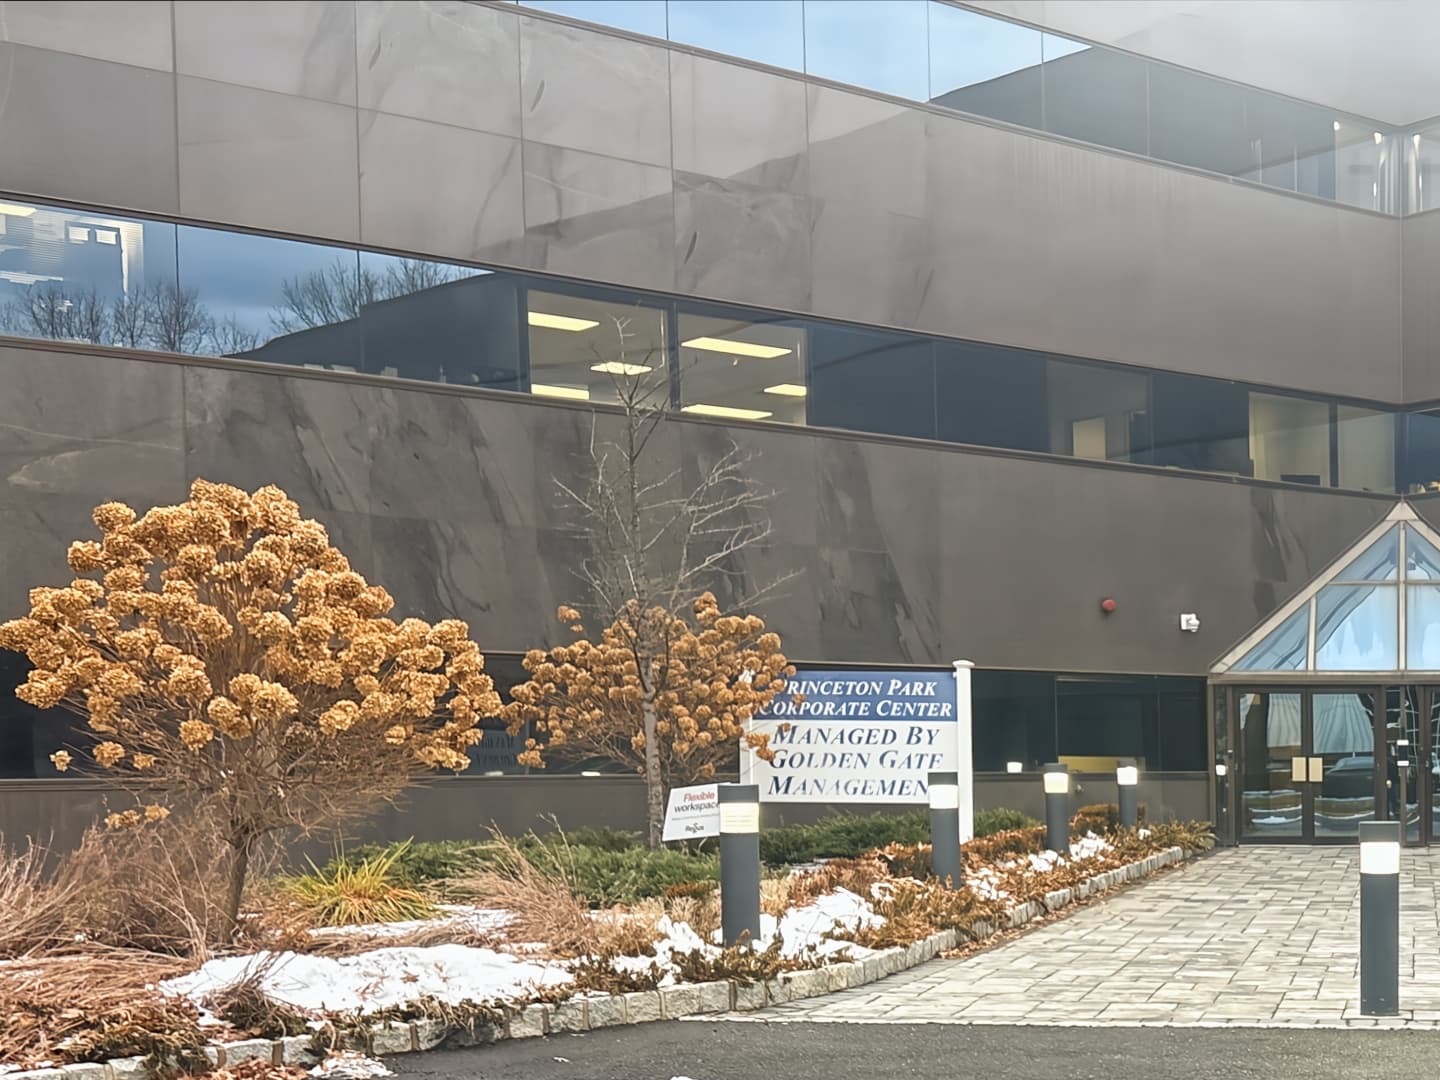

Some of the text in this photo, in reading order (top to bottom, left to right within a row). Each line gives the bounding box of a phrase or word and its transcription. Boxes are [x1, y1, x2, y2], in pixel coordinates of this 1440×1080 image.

[782, 679, 937, 696] RINCETON PARK
[876, 700, 952, 717] CENTER
[773, 725, 940, 745] MANAGED BY
[769, 748, 943, 769] GOLDEN GATE
[768, 776, 928, 796] MANAGEMEN
